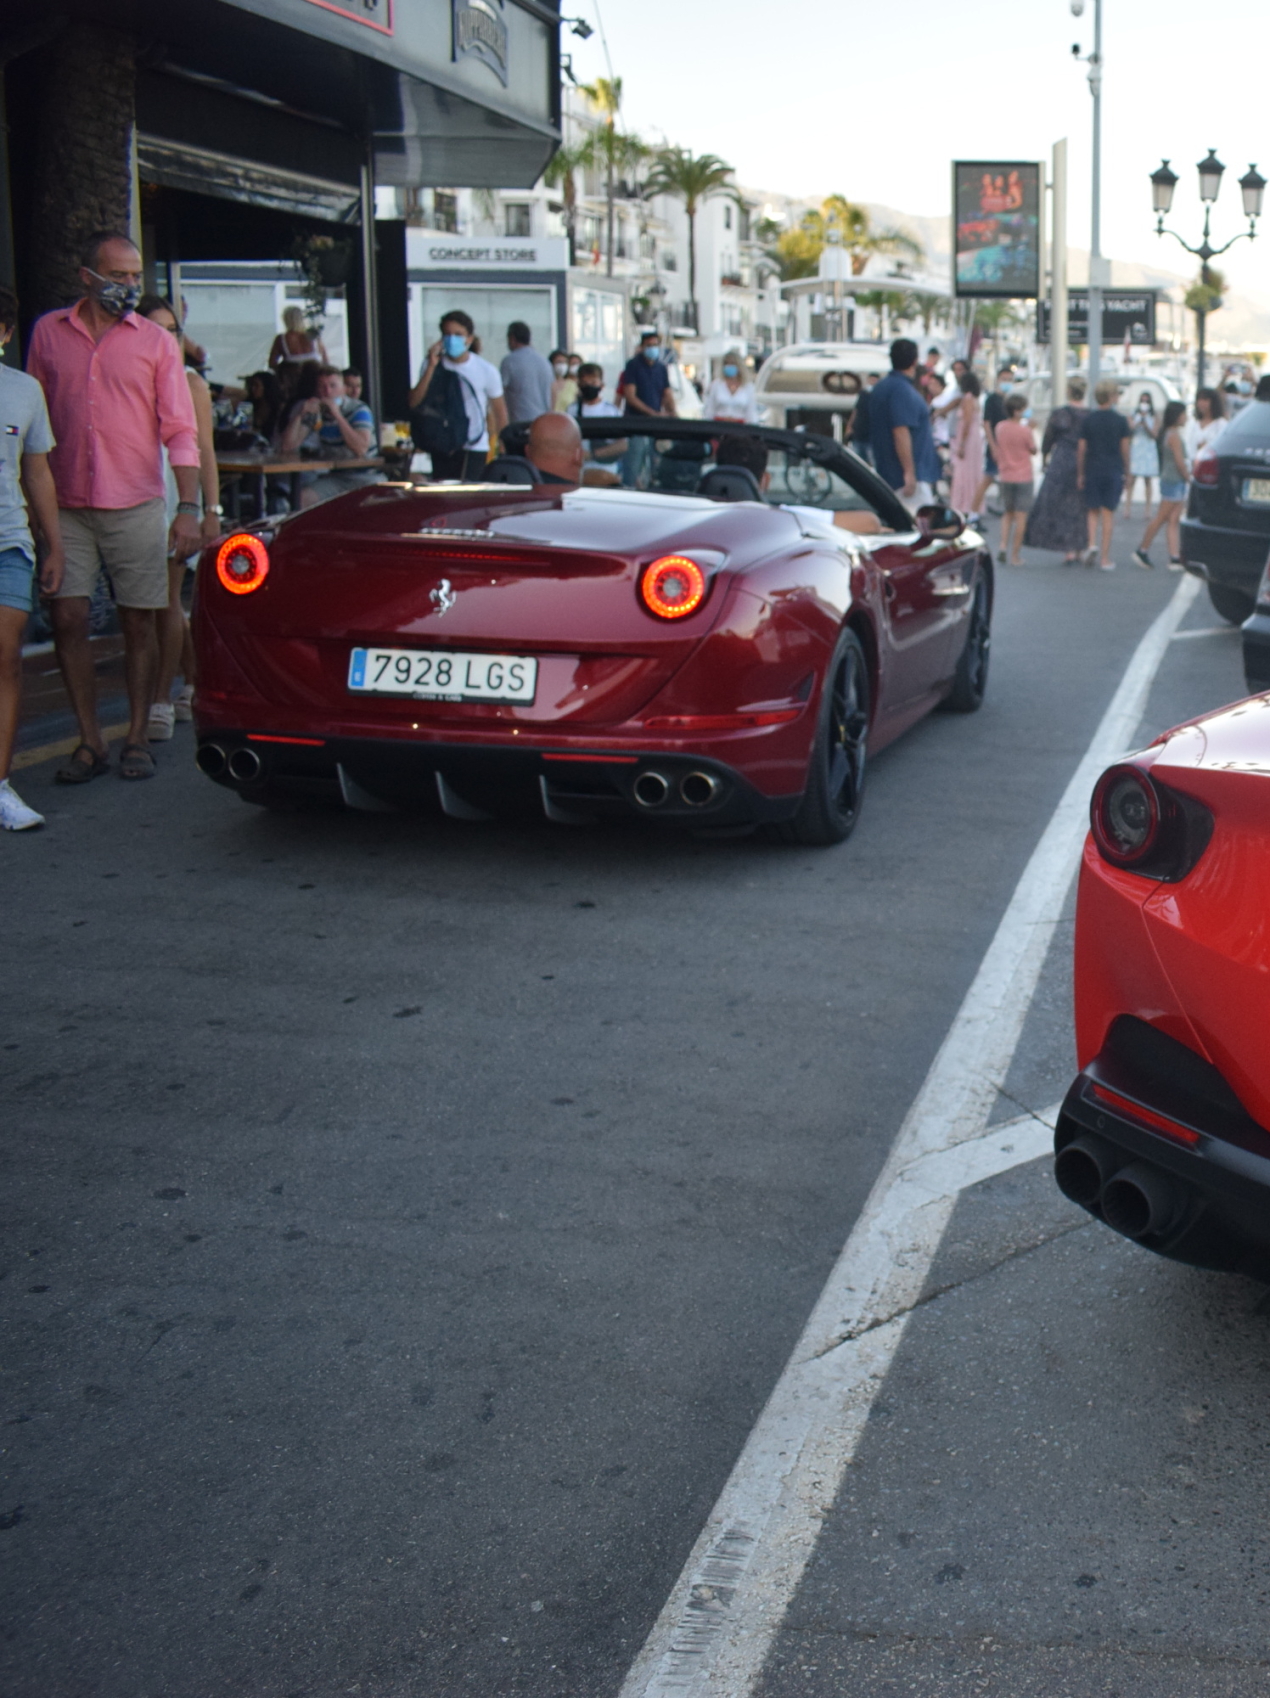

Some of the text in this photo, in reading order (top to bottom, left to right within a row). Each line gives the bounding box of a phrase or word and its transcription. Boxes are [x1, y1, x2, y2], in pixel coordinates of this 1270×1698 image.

[429, 247, 537, 262] CONCEPT STORE
[1107, 299, 1146, 313] YACHT
[373, 655, 525, 691] 7928 LGS
